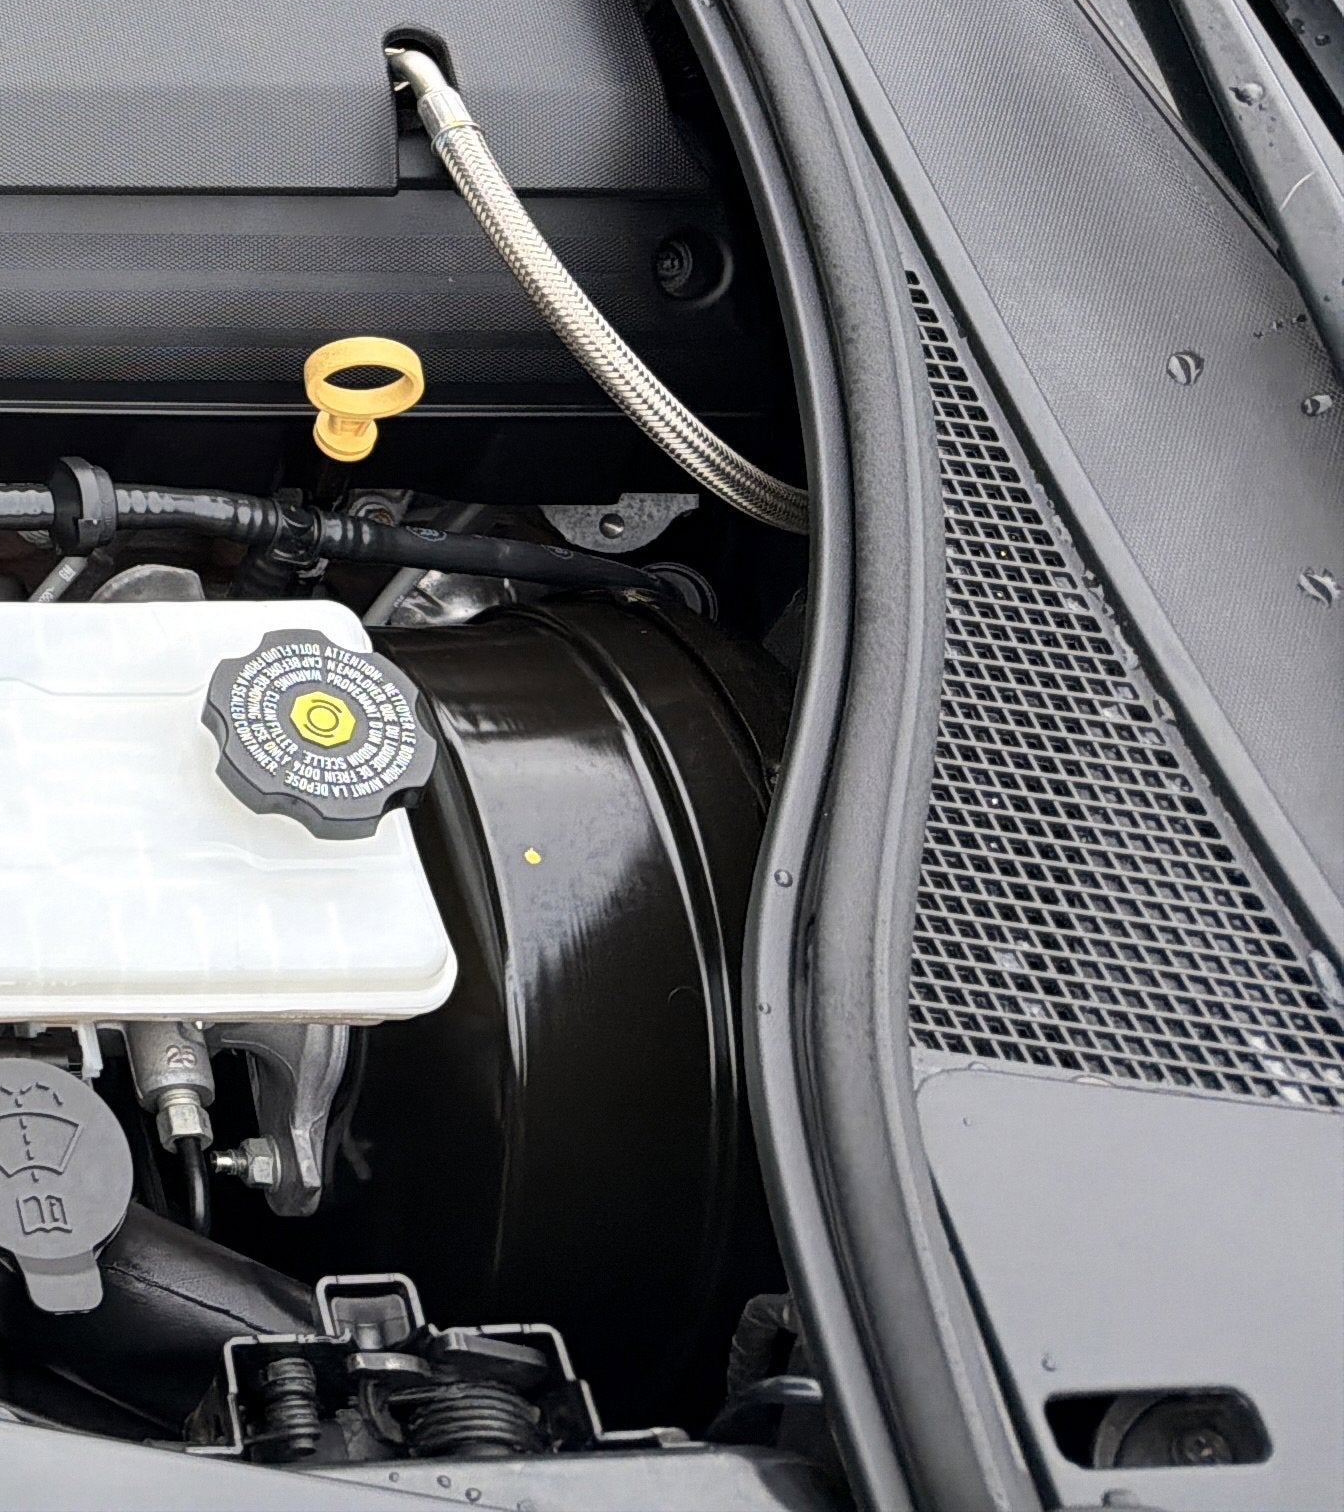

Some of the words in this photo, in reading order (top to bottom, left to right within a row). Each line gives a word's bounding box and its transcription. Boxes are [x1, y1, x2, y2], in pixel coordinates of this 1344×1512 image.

[262, 657, 301, 680] BEFORE
[302, 656, 322, 668] CAP
[230, 684, 247, 719] SEALED
[265, 722, 298, 754] FILLER
[402, 731, 417, 744] LE
[264, 741, 292, 765] ONLY
[324, 770, 358, 783] FREIN
[331, 785, 349, 797] LA
